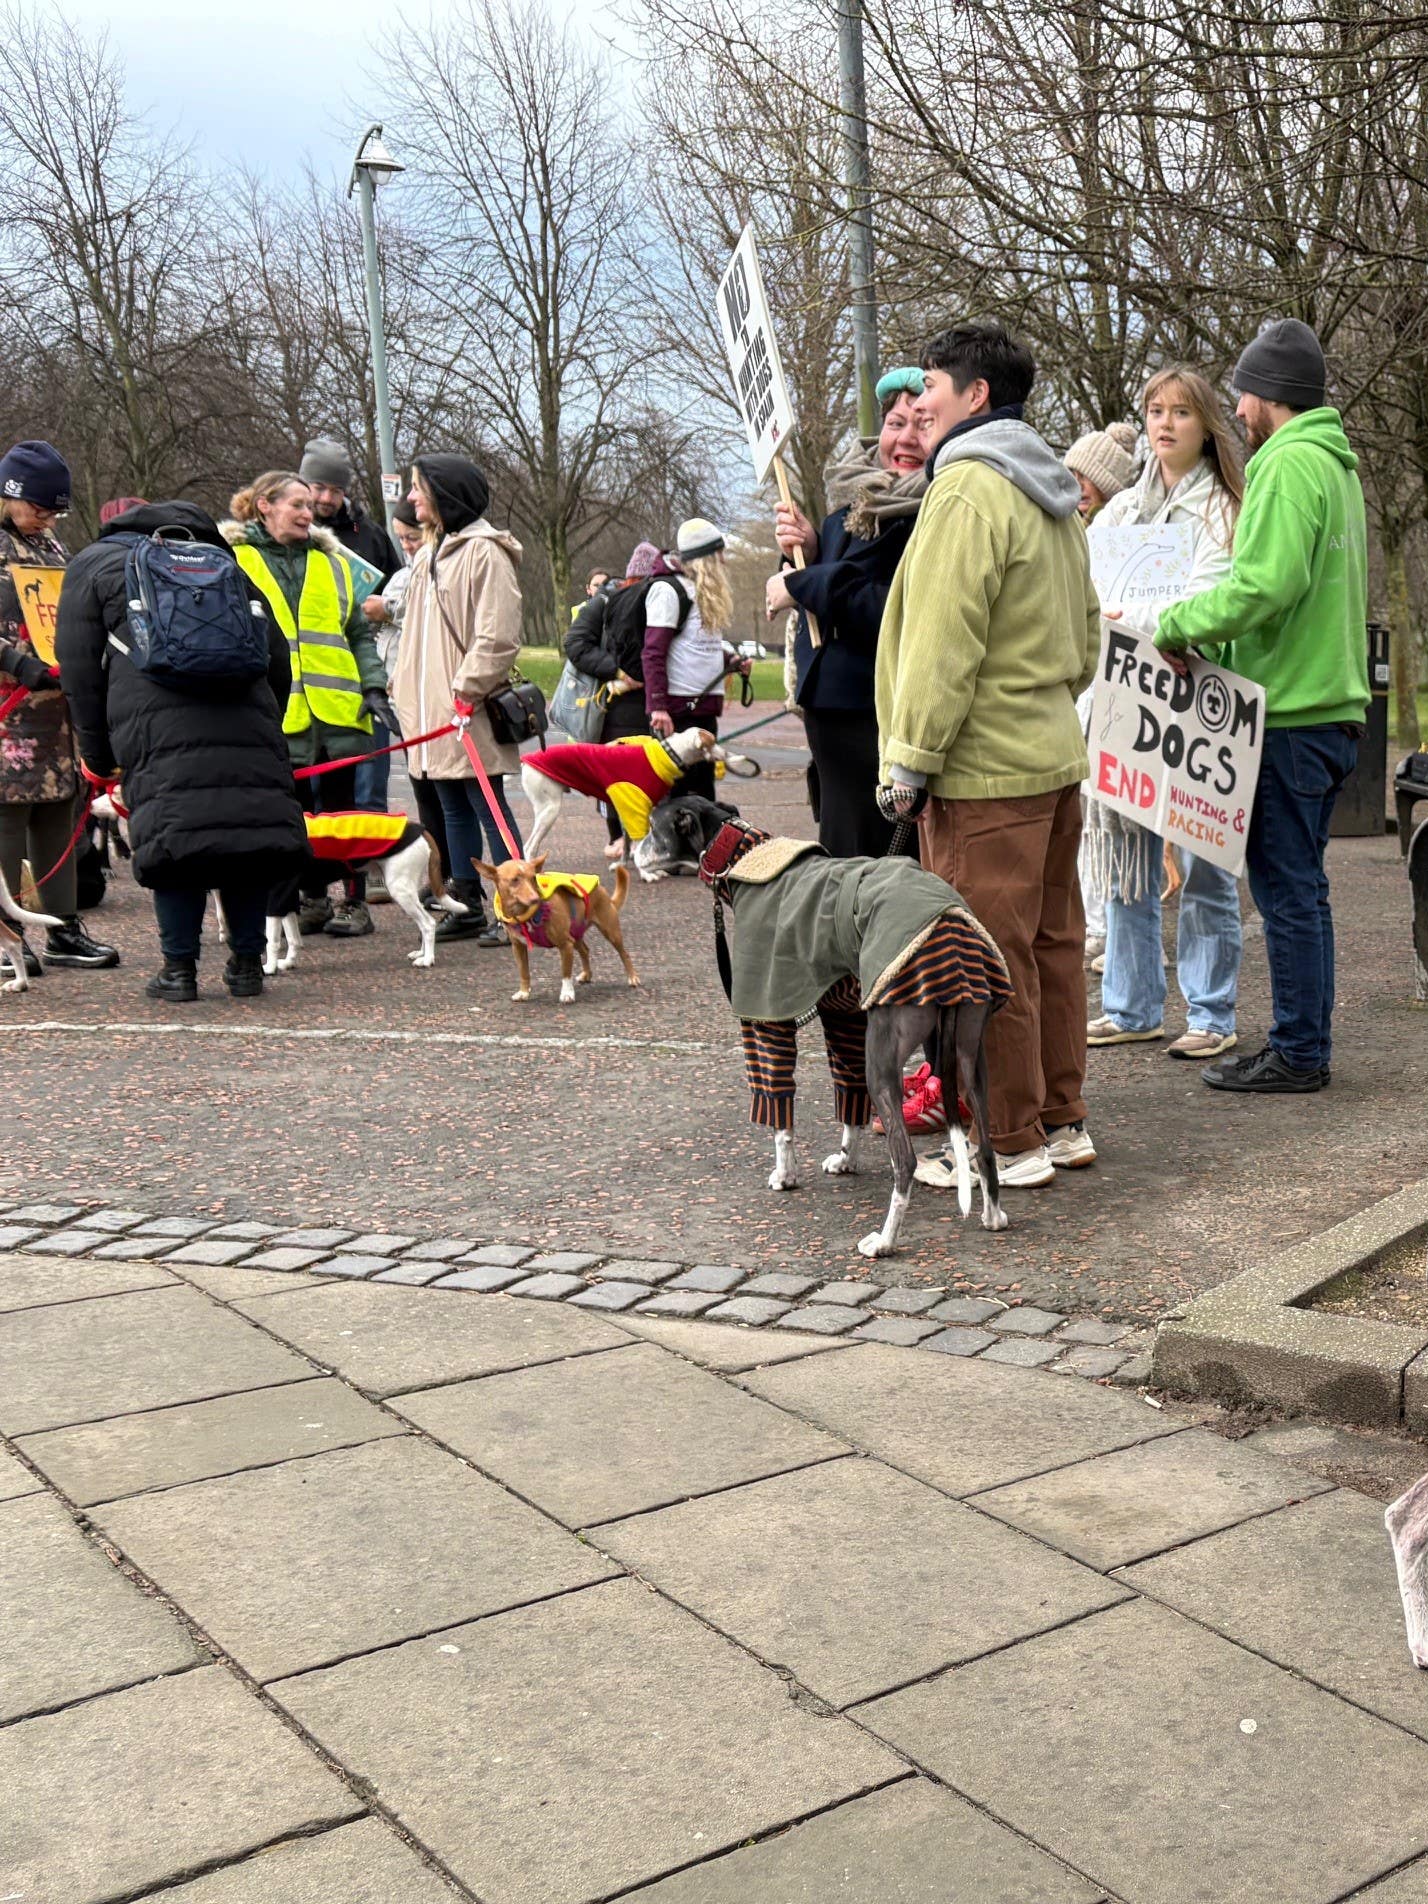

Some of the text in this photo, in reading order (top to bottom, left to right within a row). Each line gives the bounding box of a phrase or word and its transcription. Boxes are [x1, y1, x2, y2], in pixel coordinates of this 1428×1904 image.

[724, 252, 750, 344] NO
[738, 326, 767, 401] HUNTING
[756, 356, 773, 399] DOGS
[1105, 629, 1259, 747] FREEDOM
[1097, 751, 1157, 809] END
[1133, 704, 1237, 796] DOGS
[1168, 808, 1227, 848] RACING
[1170, 785, 1246, 835] HUNTING &
